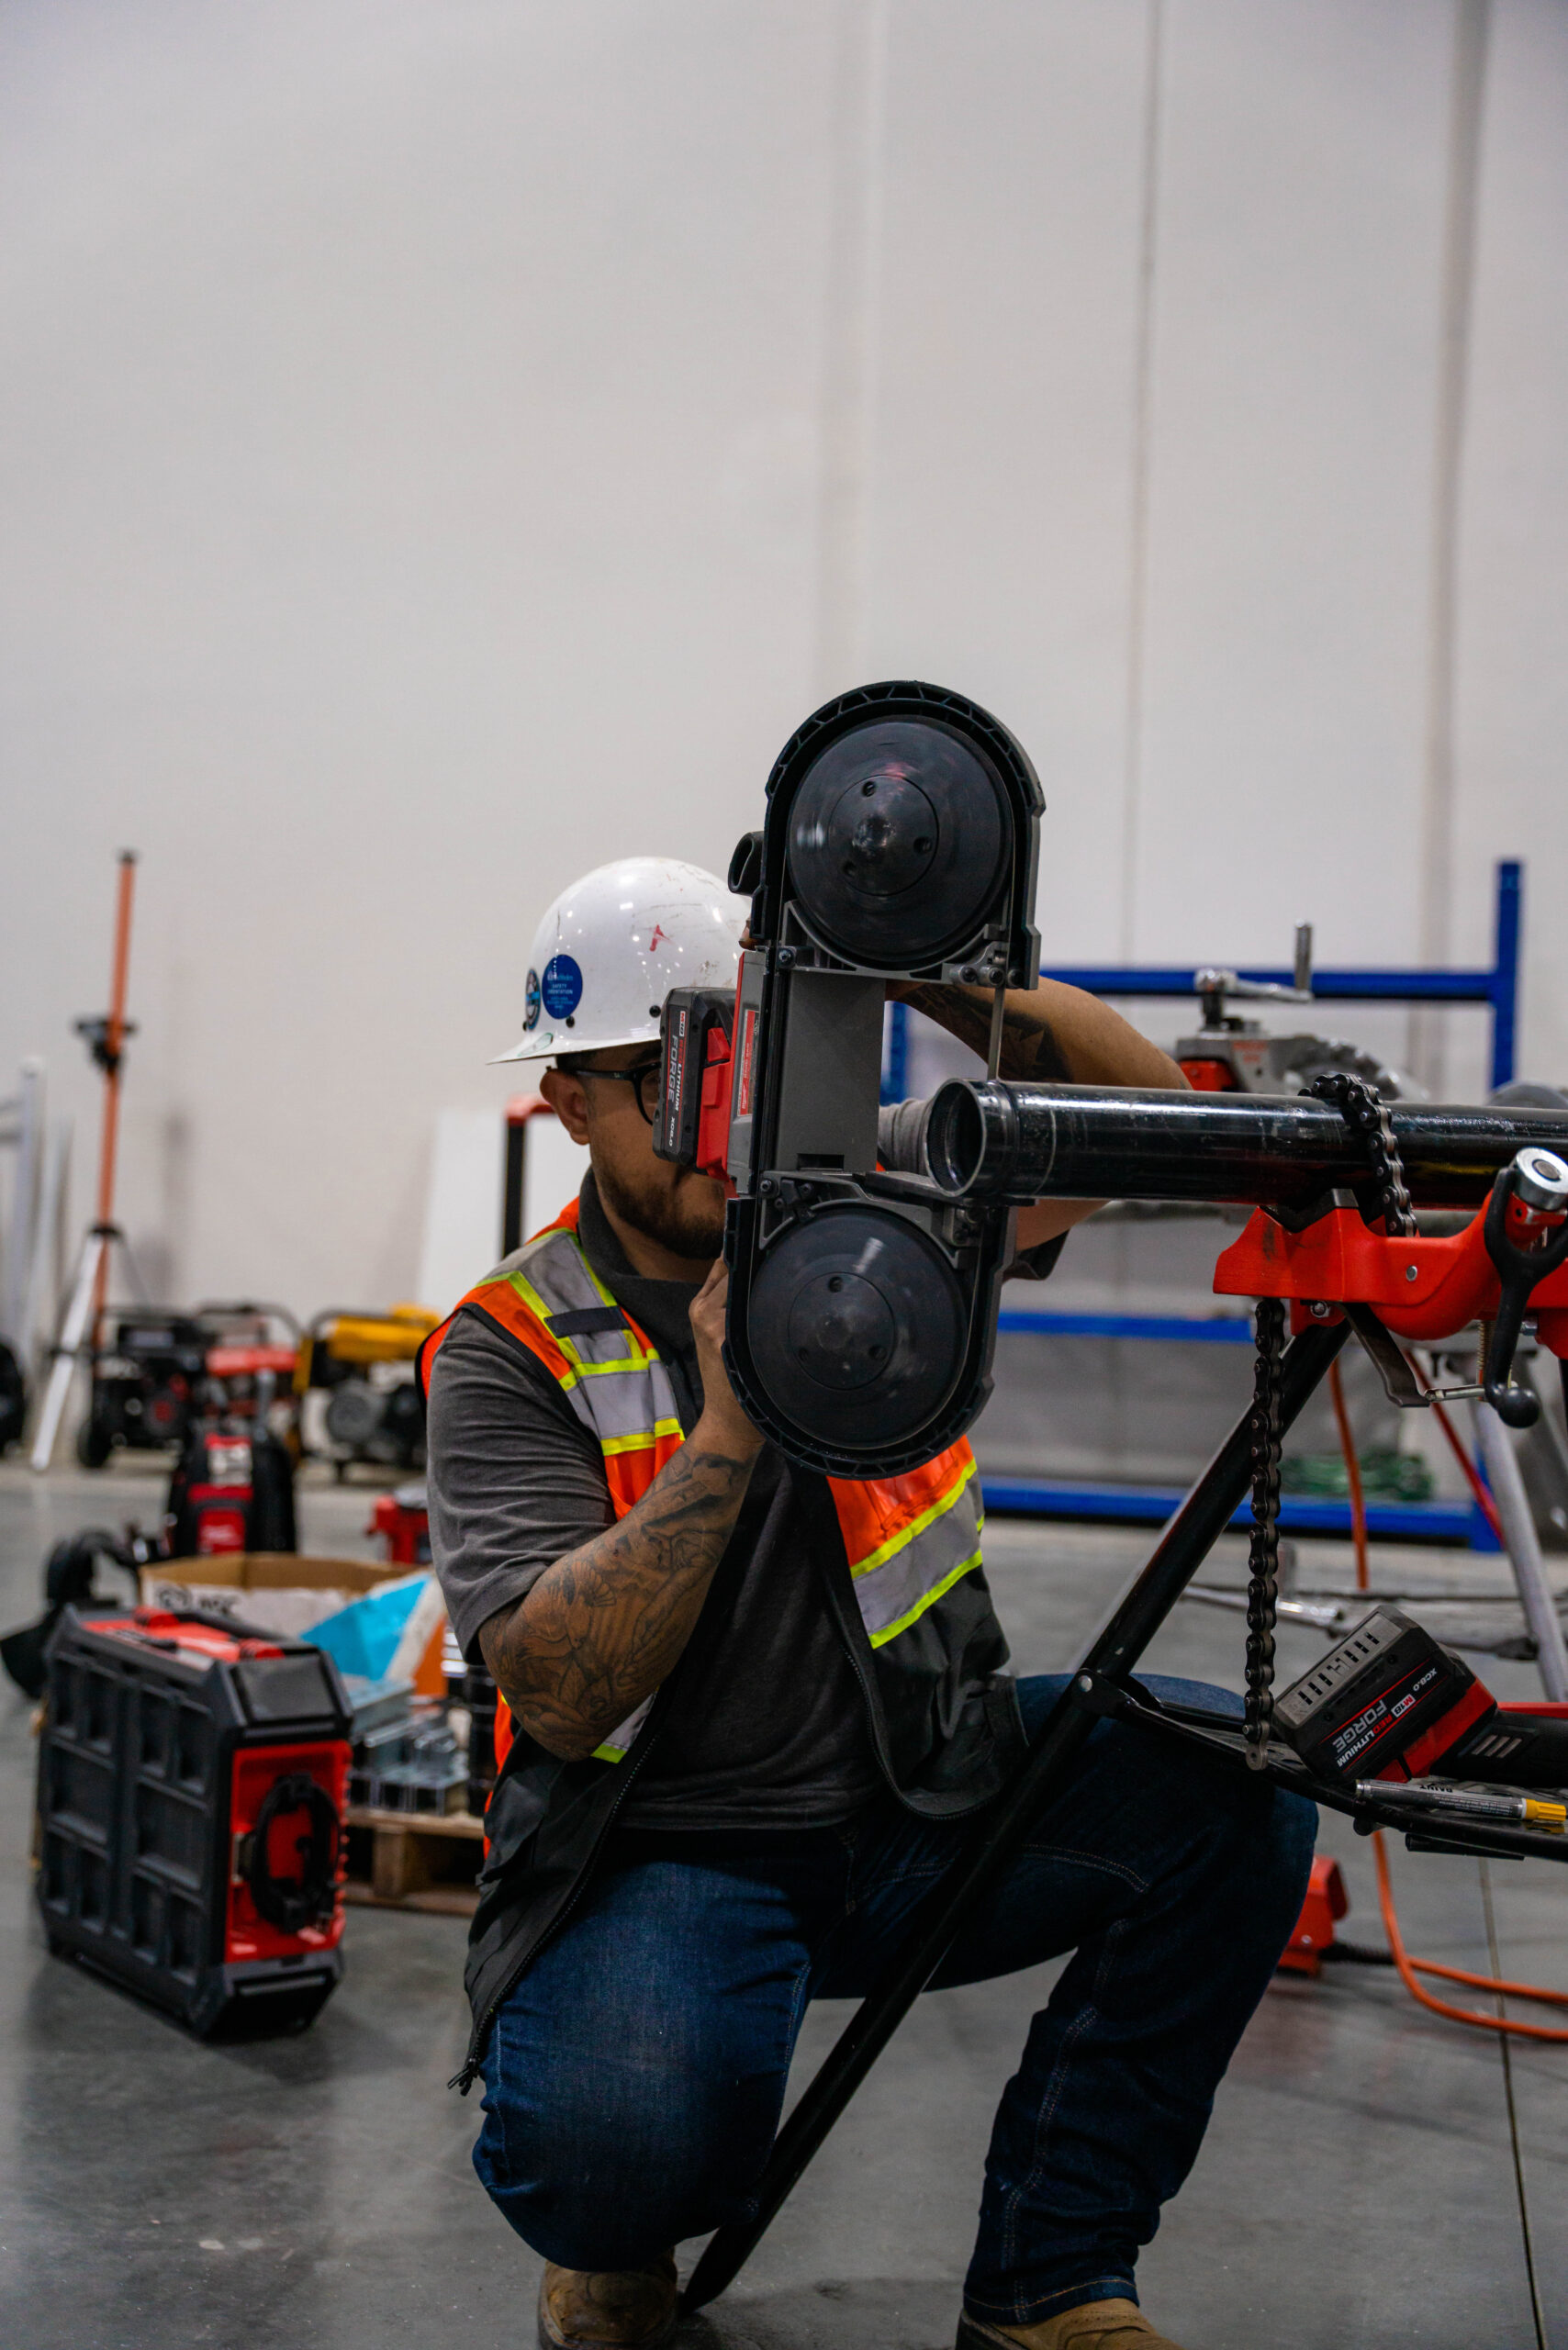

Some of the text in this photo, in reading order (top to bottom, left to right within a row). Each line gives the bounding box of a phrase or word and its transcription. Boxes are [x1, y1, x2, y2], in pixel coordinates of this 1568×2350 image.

[667, 1035, 679, 1102] FORGE
[674, 1039, 685, 1113] REDLITHIUM
[1413, 1667, 1438, 1692] XC8.0
[1332, 1699, 1387, 1754] FORGE
[1337, 1695, 1415, 1768] M18 REDLITHIUM
